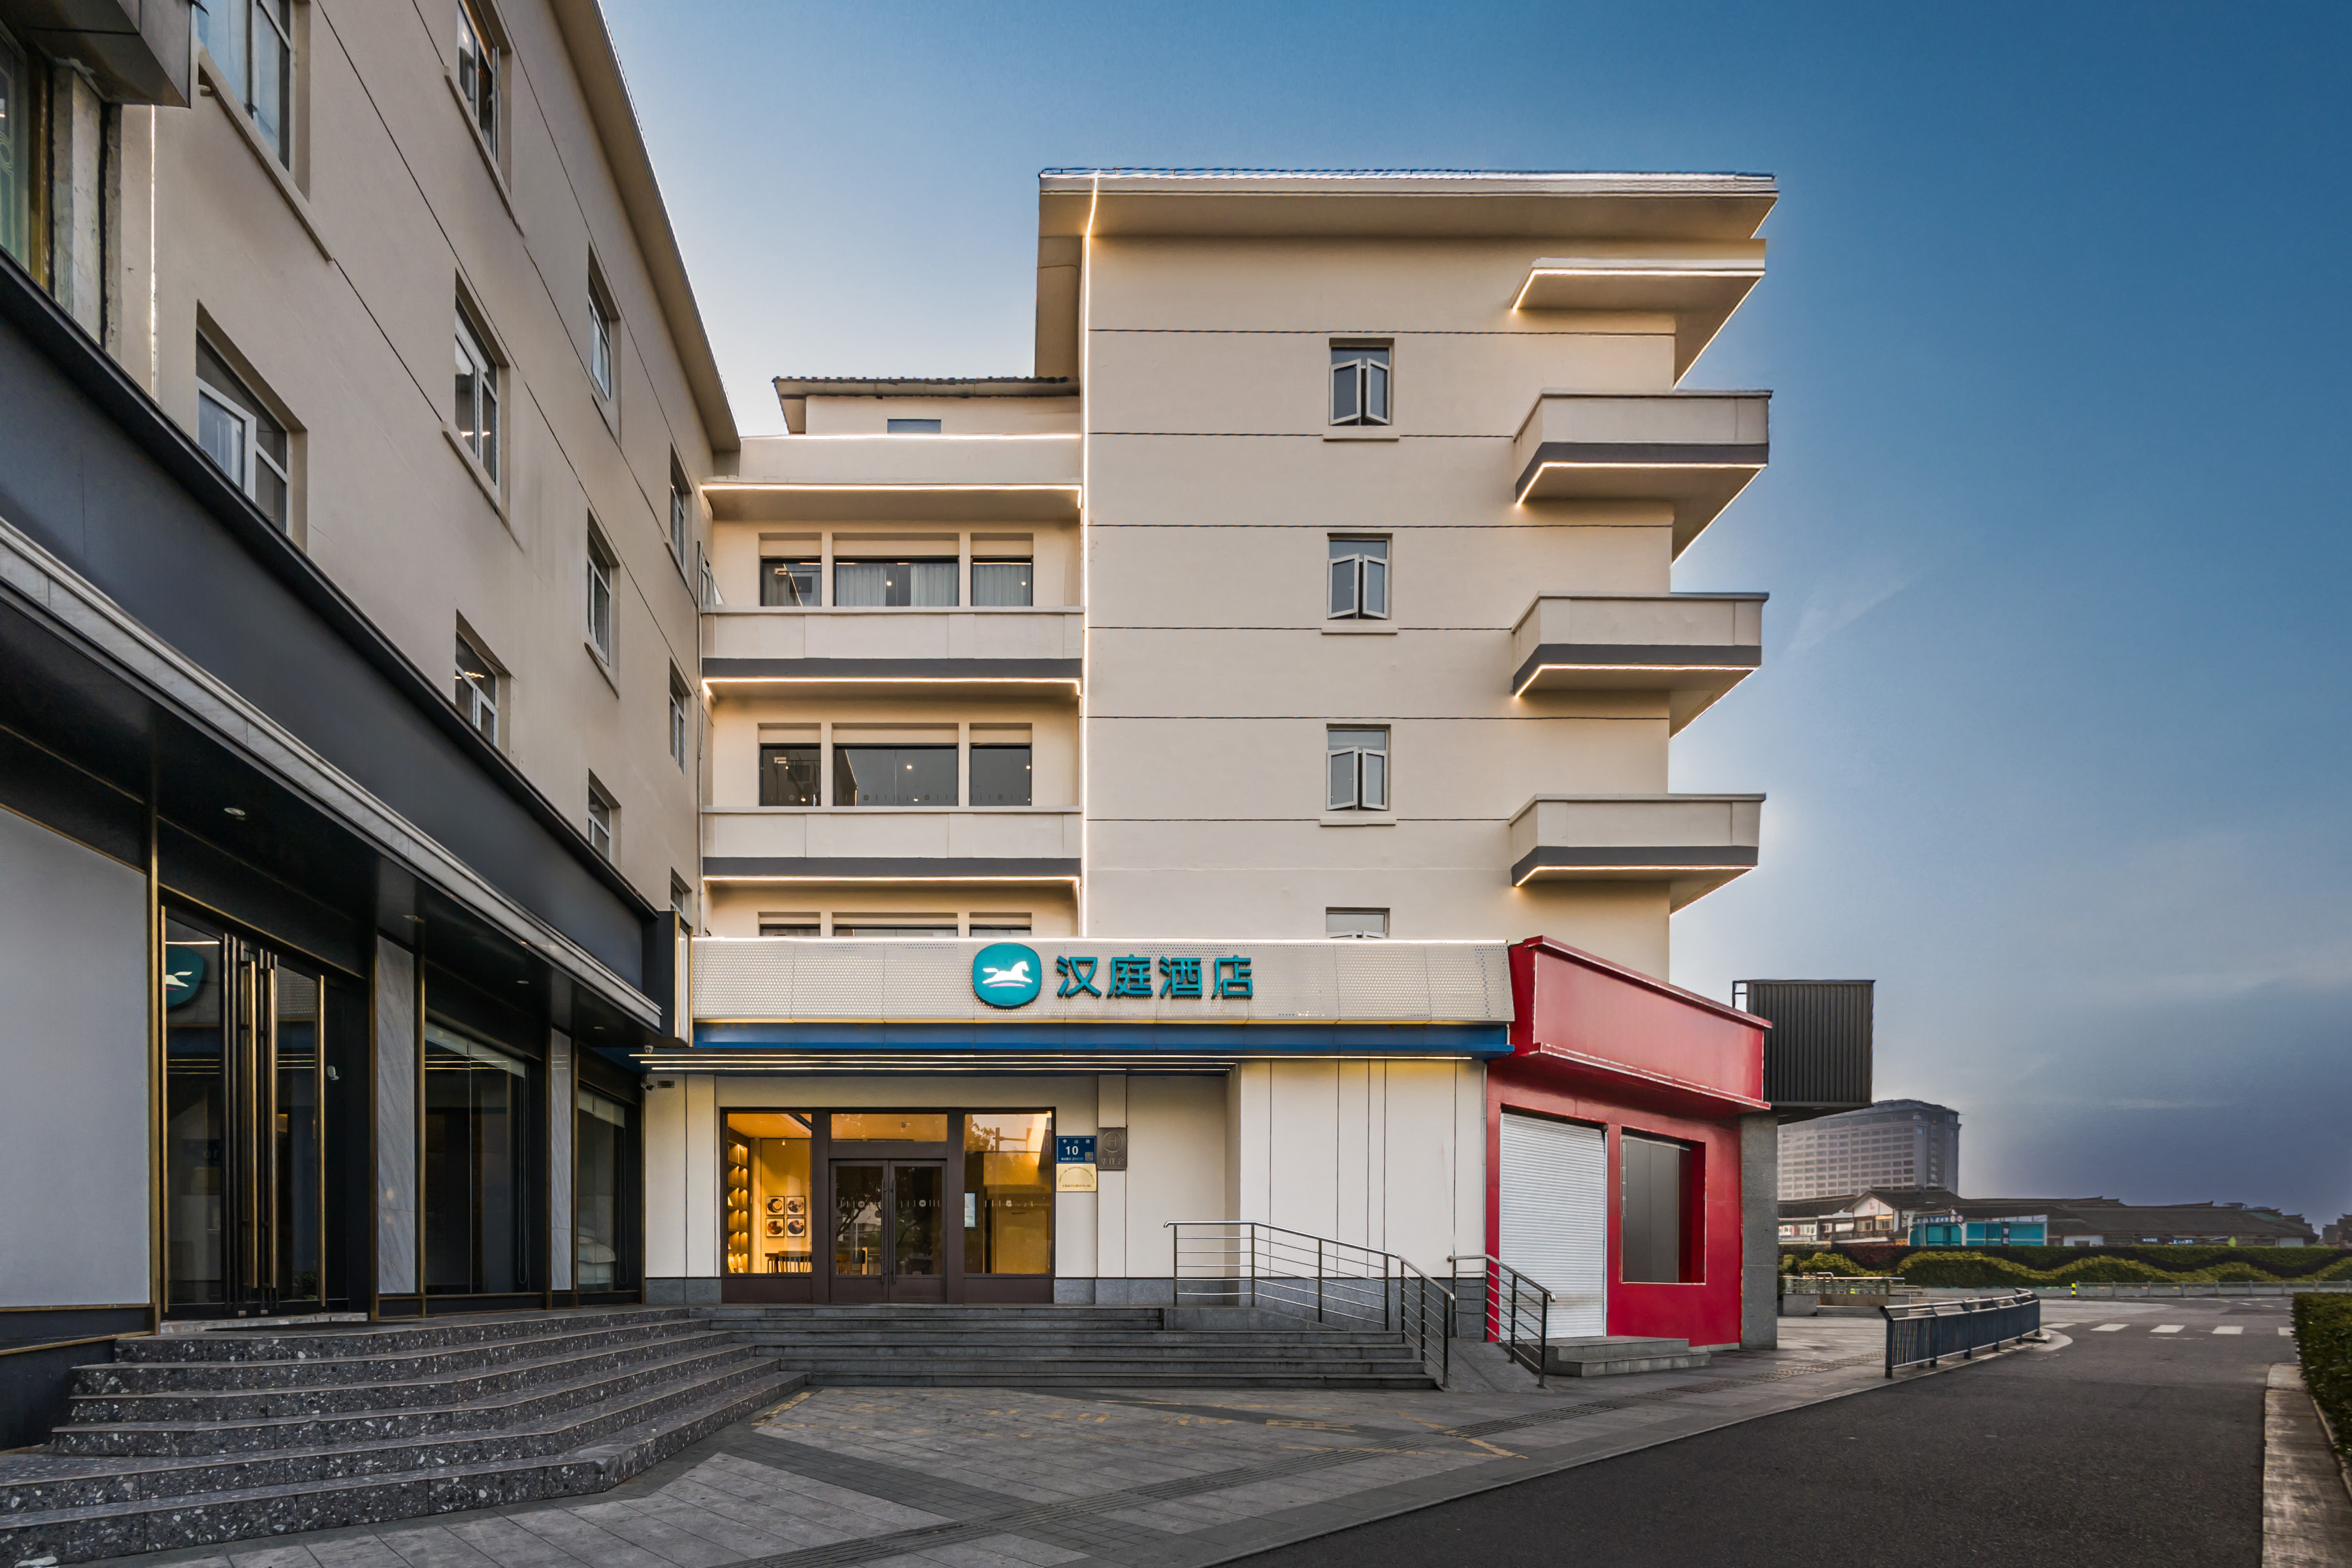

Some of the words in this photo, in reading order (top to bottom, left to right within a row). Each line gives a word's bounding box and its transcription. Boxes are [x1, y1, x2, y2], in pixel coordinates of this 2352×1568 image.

[1056, 954, 1253, 1000] 汉庭酒店
[1066, 1145, 1079, 1155] 10
